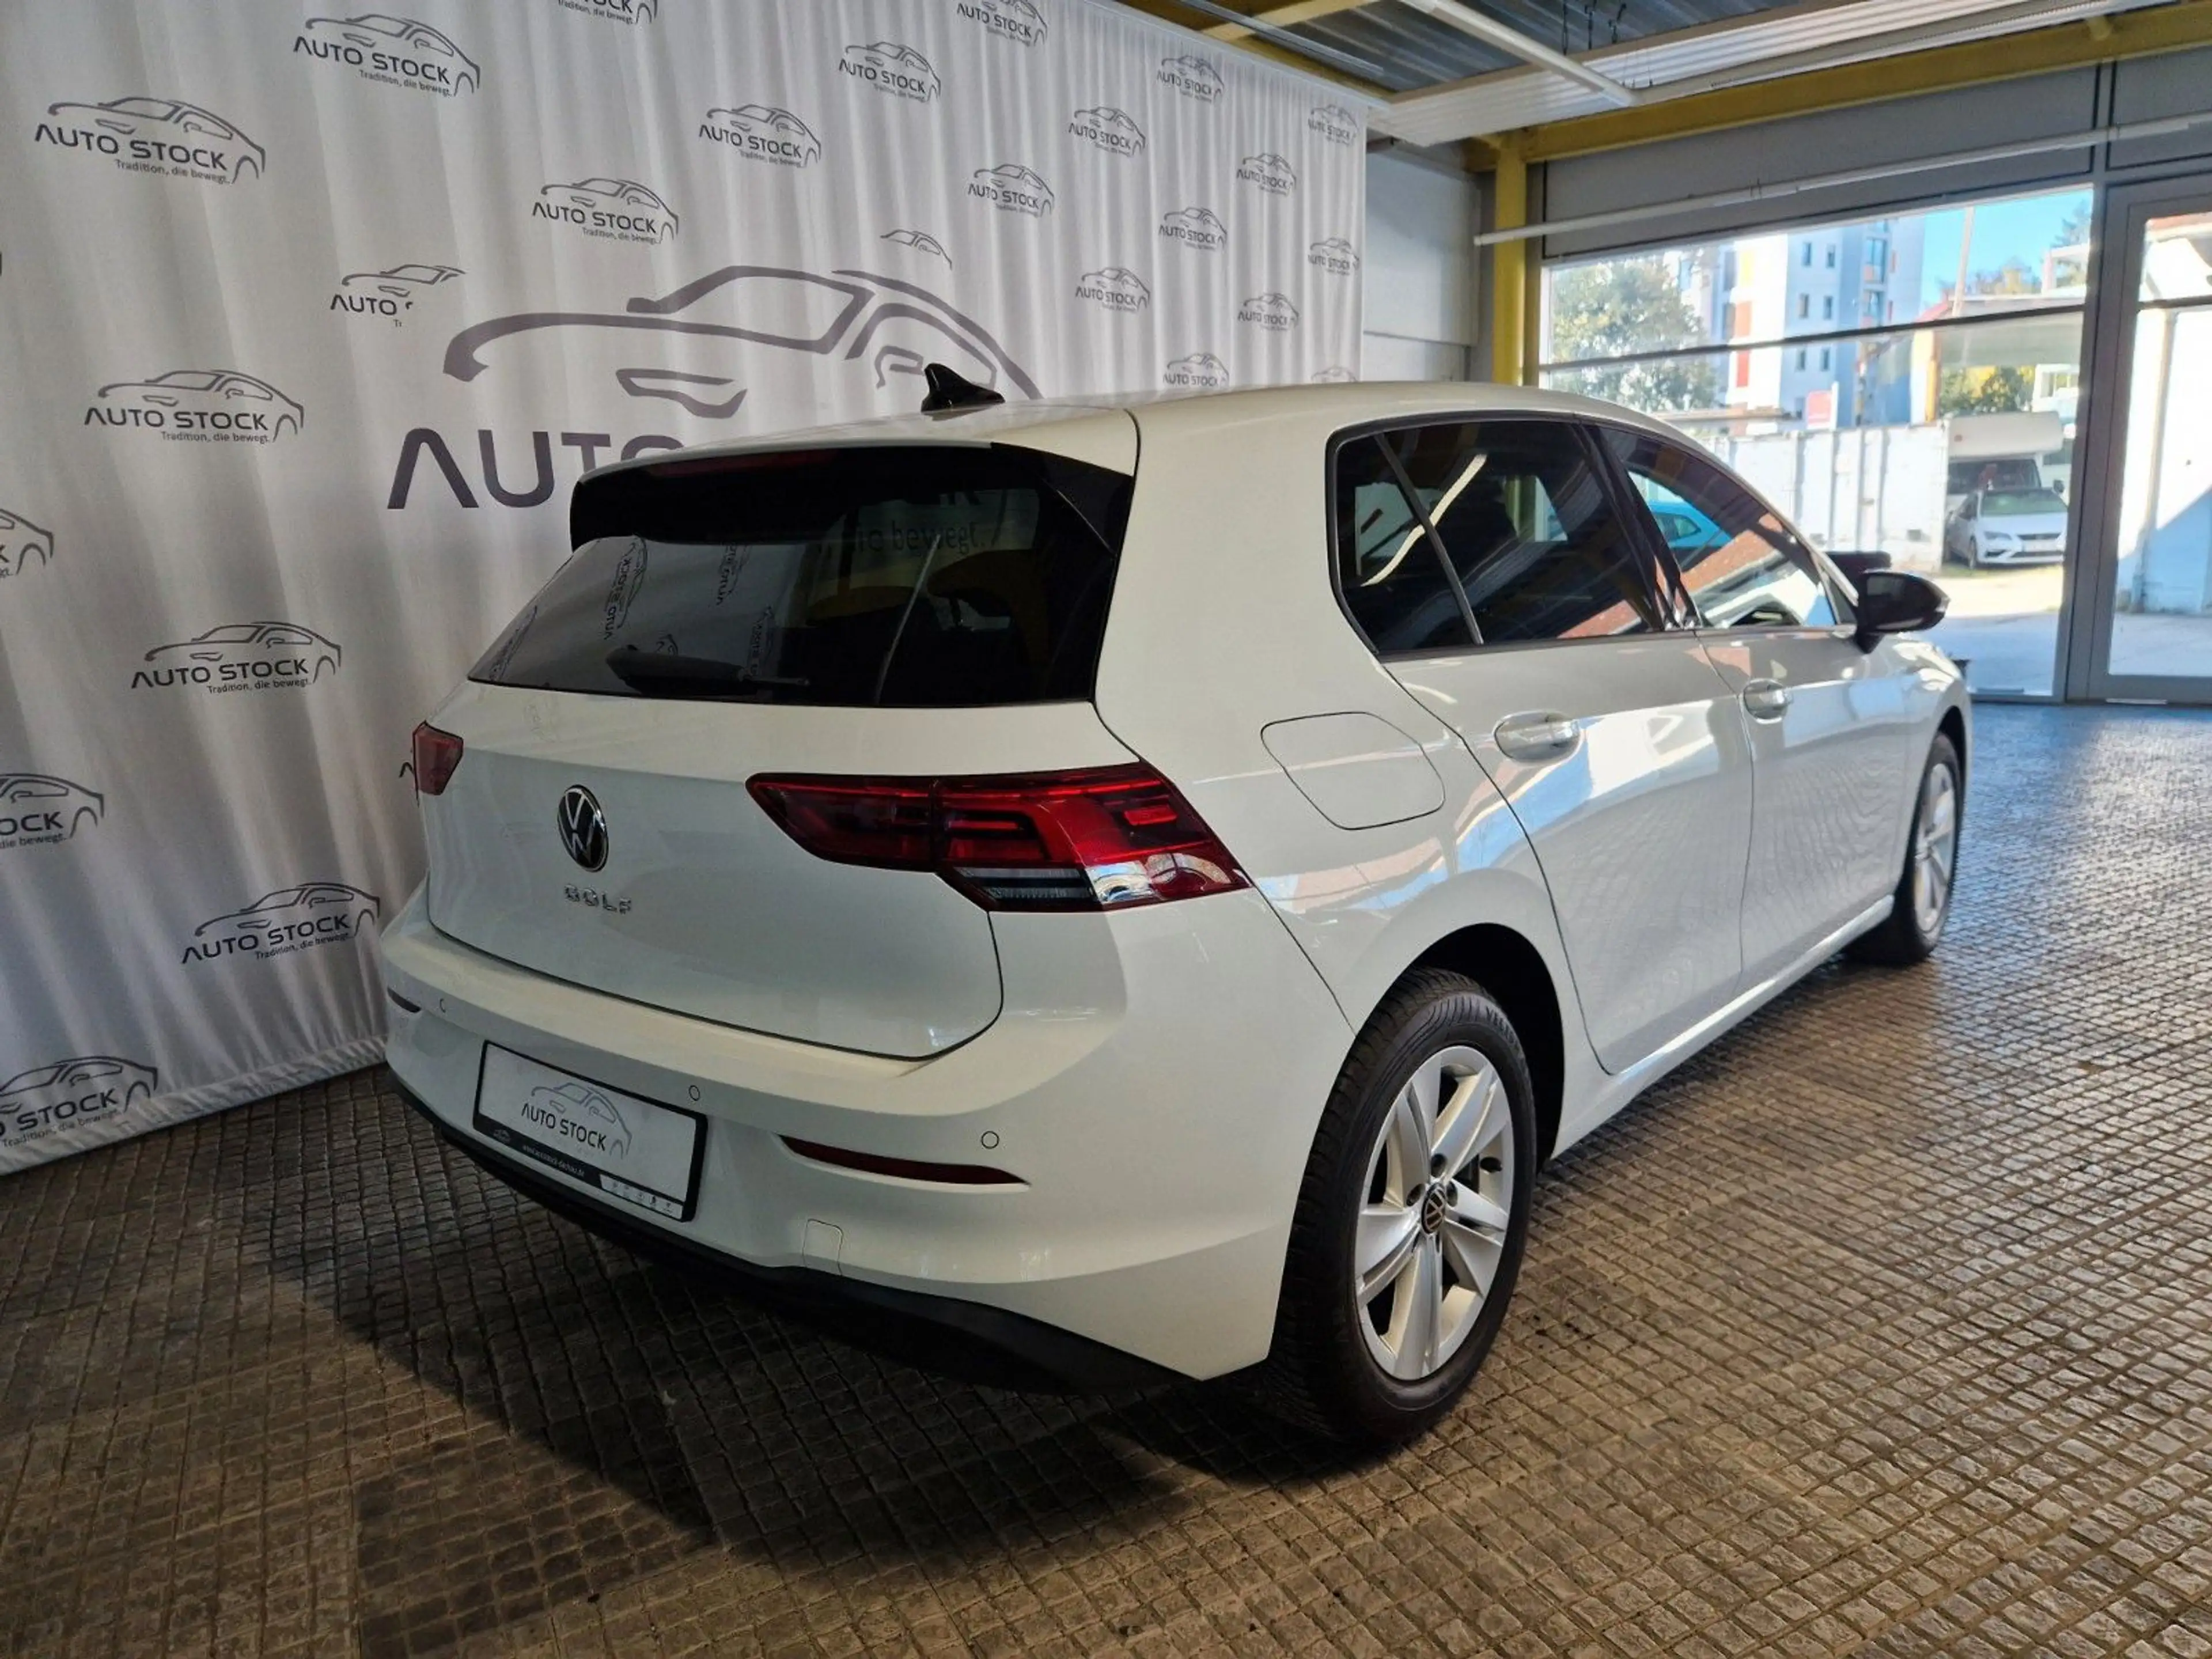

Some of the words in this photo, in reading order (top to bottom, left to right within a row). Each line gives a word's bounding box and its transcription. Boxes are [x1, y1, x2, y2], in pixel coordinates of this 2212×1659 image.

[957, 3, 989, 24] AUTO
[994, 14, 1032, 39] STOCK
[293, 36, 363, 65] AUTO
[372, 52, 450, 85] STOCK
[839, 58, 877, 79] AUTO
[881, 70, 926, 94] STOCK
[35, 123, 119, 154] AUTO
[130, 139, 227, 171] STOCK
[699, 124, 742, 146] AUTO
[748, 135, 802, 158] STOCK
[1069, 123, 1097, 139] AUTO
[968, 183, 998, 200] AUTO
[1002, 190, 1039, 209] STOCK
[532, 202, 586, 224] AUTO
[592, 212, 657, 234] STOCK
[330, 294, 397, 315] AUTO
[1075, 286, 1104, 301] AUTO
[85, 408, 165, 427] AUTO
[173, 411, 268, 431] STOCK
[131, 666, 211, 689] AUTO
[219, 658, 309, 681] STOCK
[181, 934, 259, 964] AUTO
[267, 914, 350, 945] STOCK
[17, 1088, 119, 1131] STOCK
[521, 1103, 555, 1129] AUTO
[559, 1118, 607, 1152] STOCK
